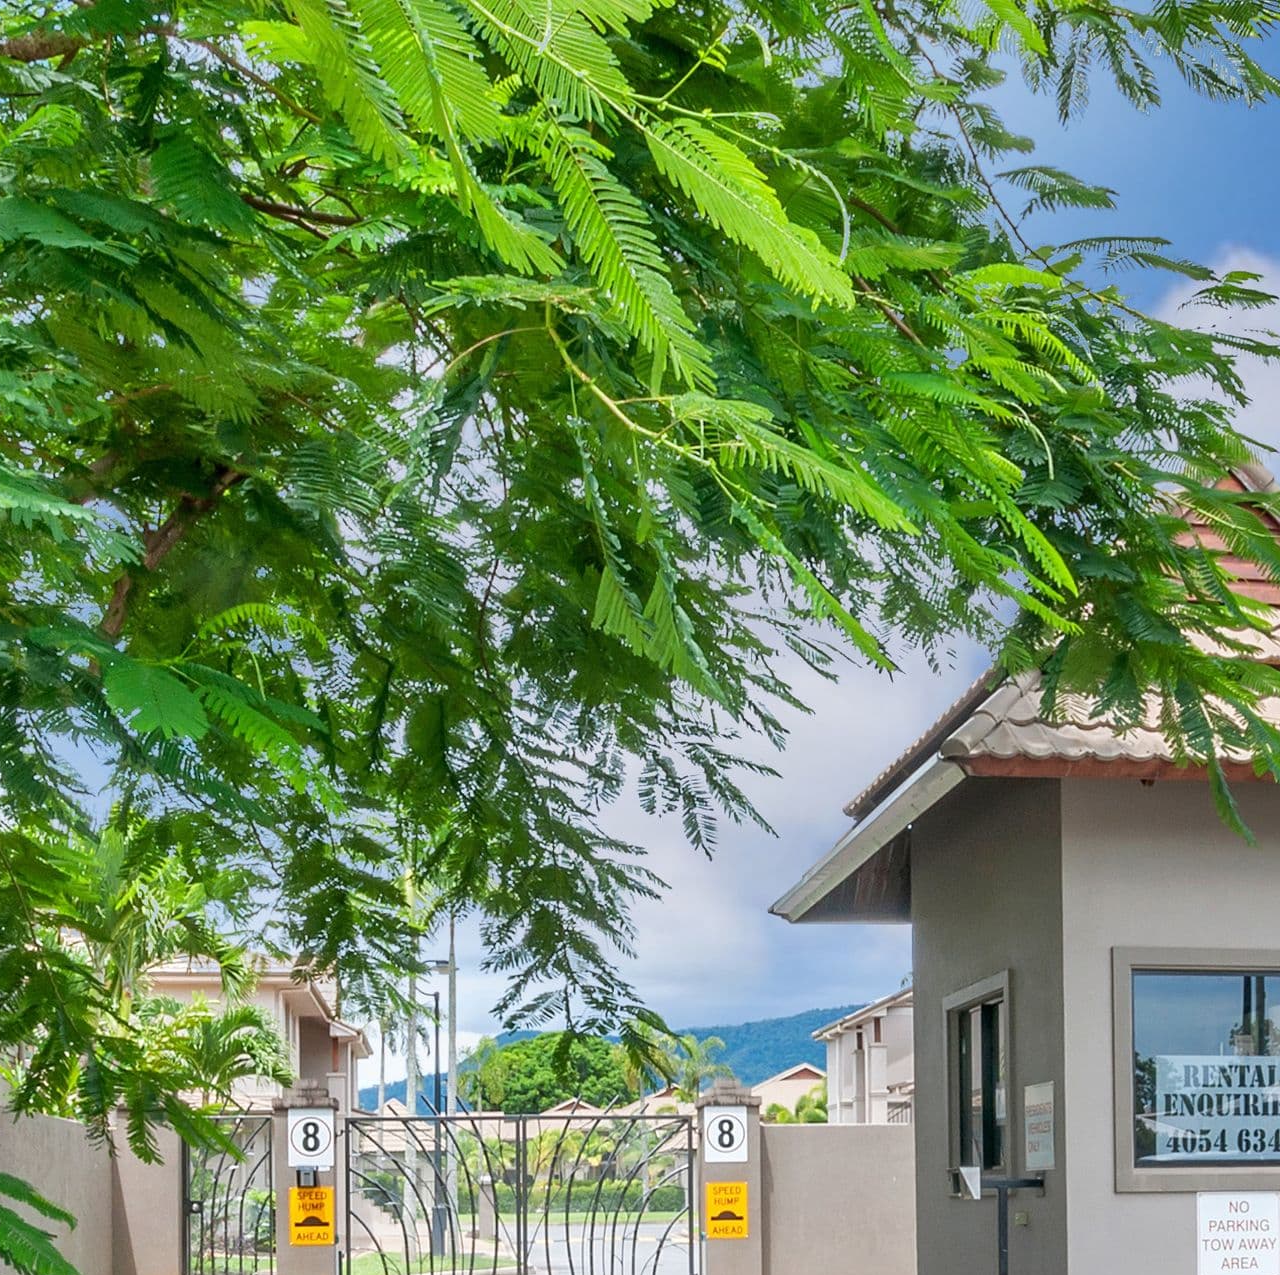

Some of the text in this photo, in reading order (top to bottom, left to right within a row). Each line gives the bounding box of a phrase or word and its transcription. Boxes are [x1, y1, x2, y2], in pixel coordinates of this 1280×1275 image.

[1183, 1064, 1280, 1088] RENTAL
[302, 1121, 320, 1152] 8
[718, 1119, 734, 1148] 8
[1166, 1128, 1228, 1153] 4054
[297, 1191, 327, 1201] SPEED
[713, 1186, 741, 1196] SPEED
[298, 1202, 325, 1211] HUMP
[713, 1197, 739, 1206] HUMP
[1228, 1200, 1250, 1214] NO
[712, 1225, 743, 1235] AHEAD
[1208, 1218, 1270, 1232] PARKING
[296, 1232, 329, 1241] AHEAD
[1202, 1237, 1277, 1252] TOW AWAY
[1221, 1256, 1259, 1270] AREA
